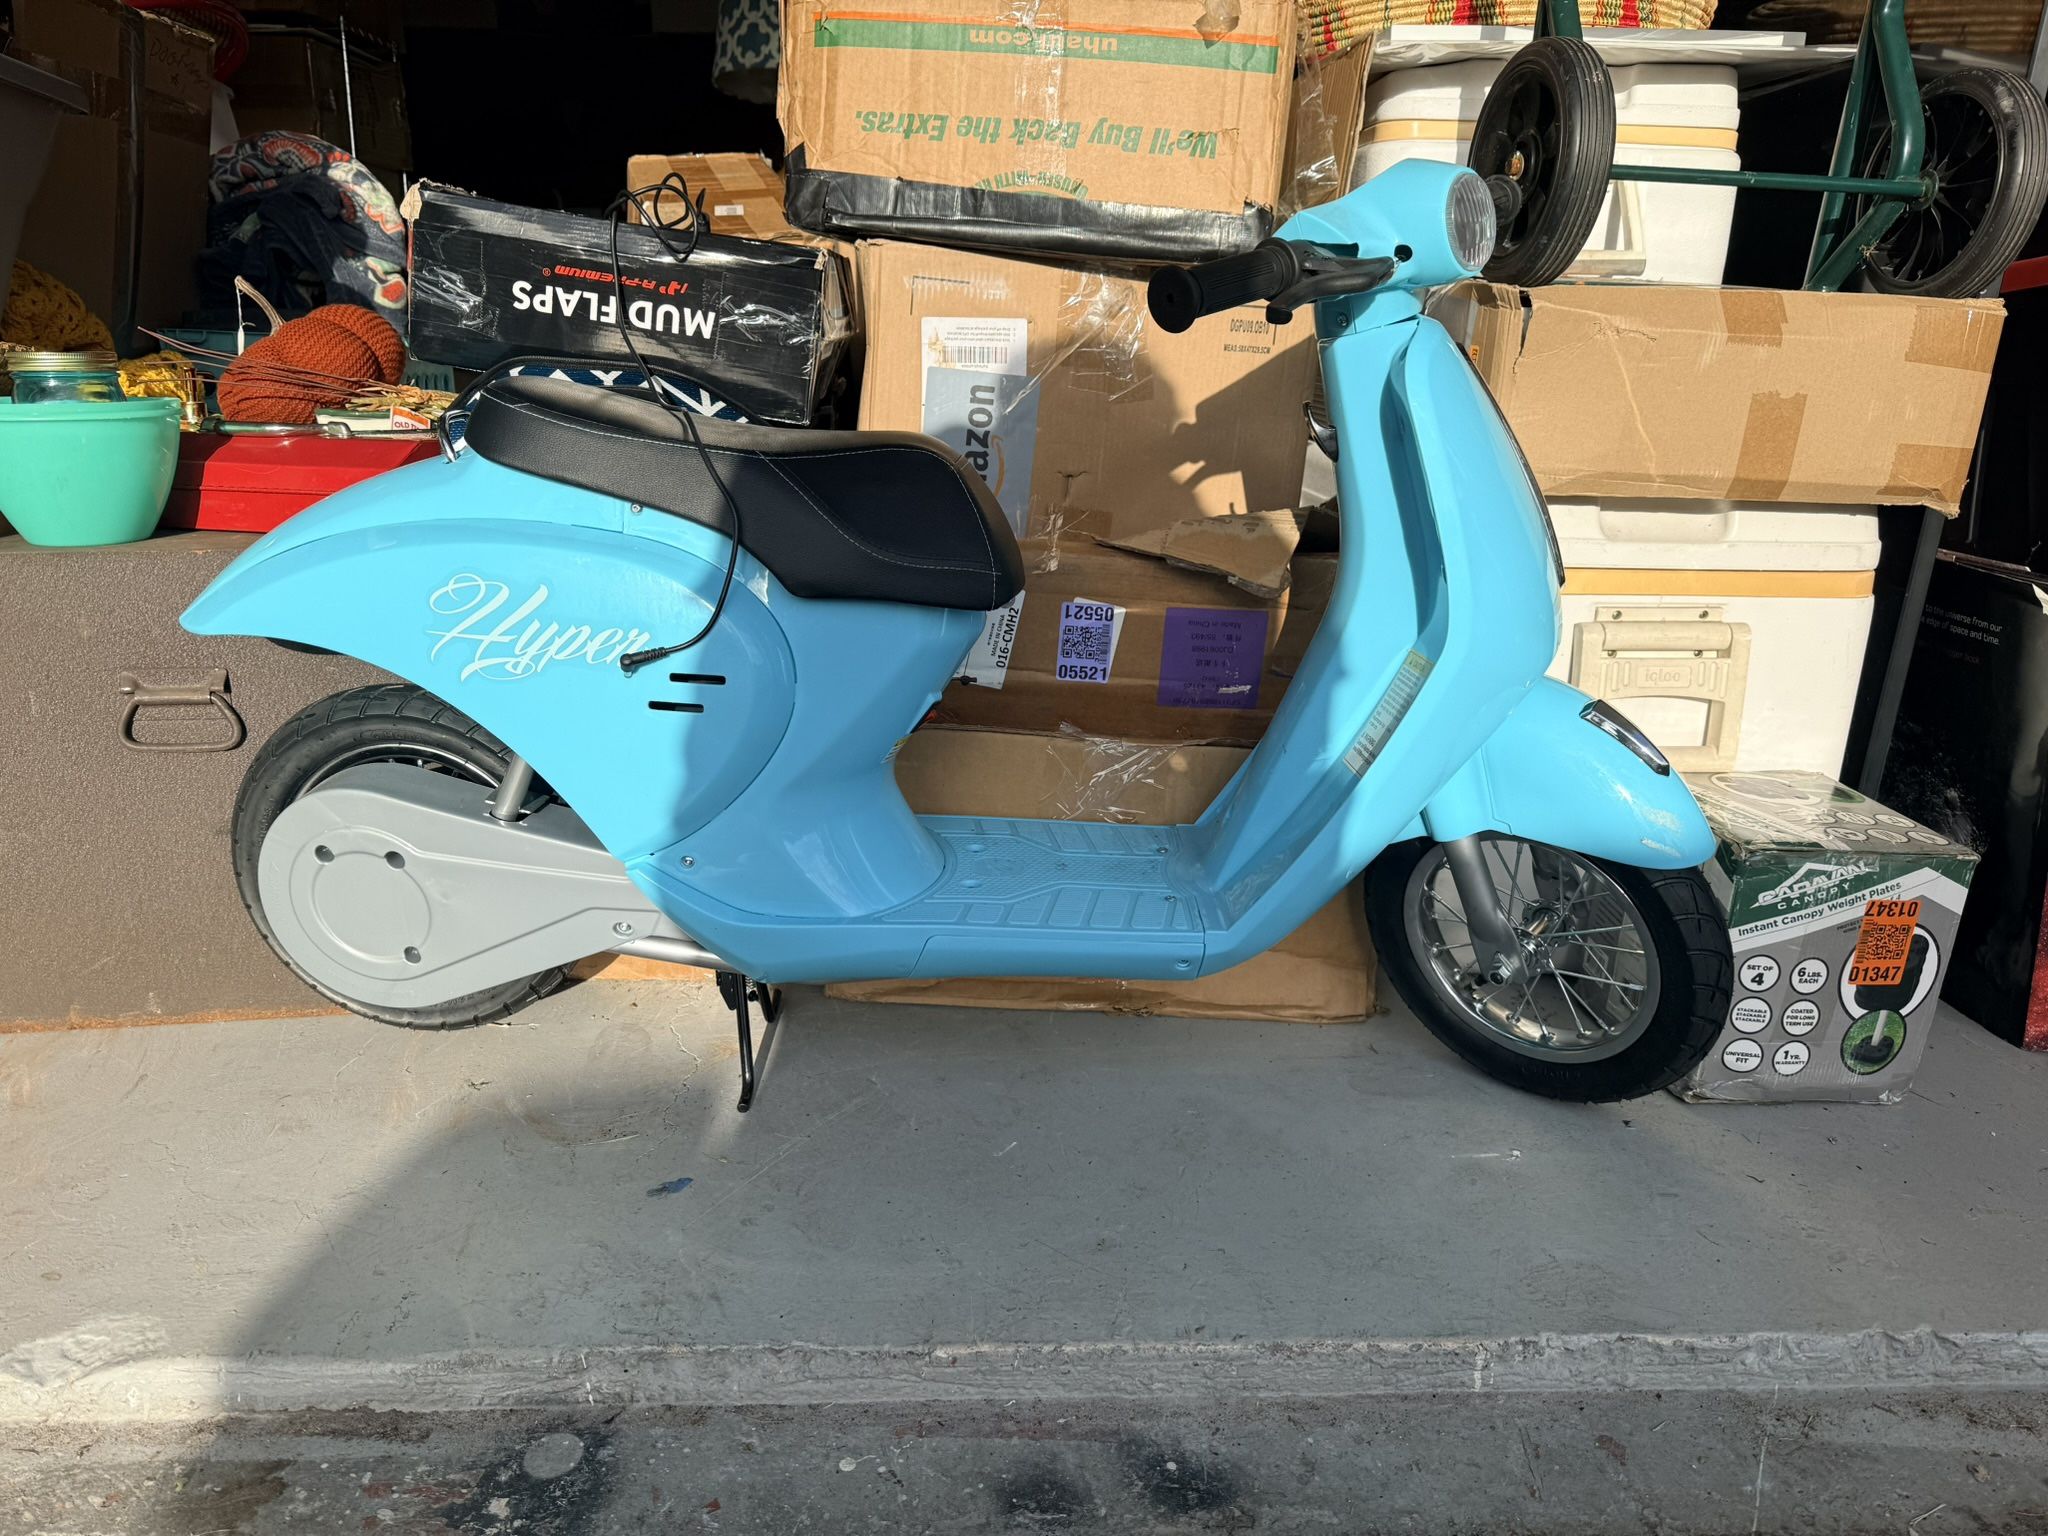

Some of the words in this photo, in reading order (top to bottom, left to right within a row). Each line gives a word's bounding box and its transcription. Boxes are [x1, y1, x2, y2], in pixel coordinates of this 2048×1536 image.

[969, 29, 1118, 56] uhaul.com
[854, 110, 949, 142] Extras.
[956, 115, 1002, 143] the
[1012, 118, 1081, 150] Back
[1086, 118, 1144, 154] Buy
[1147, 127, 1218, 160] We'll
[511, 280, 617, 322] FLAPS
[628, 299, 717, 340] MUD
[394, 421, 410, 429] OLD
[1064, 604, 1114, 622] 05521
[1971, 616, 1989, 629] from
[1989, 623, 2003, 633] our
[424, 573, 651, 684] Hyper
[996, 607, 1020, 668] 016-CMH2
[1949, 624, 1969, 637] space
[1969, 630, 1983, 640] and
[1058, 664, 1107, 681] 05521
[1644, 668, 1681, 686] igloo
[1757, 861, 1870, 906] CARAVAN
[1777, 882, 1850, 910] CANOPY
[1738, 920, 1779, 937] Instant
[1781, 907, 1824, 926] Canopy
[1827, 892, 1867, 913] Weight
[1869, 880, 1902, 899] Plates
[1865, 901, 1918, 917] 01347
[1750, 972, 1764, 986] 4
[1797, 967, 1806, 977] 6
[1849, 966, 1901, 982] 01347
[1783, 1050, 1790, 1060] 1
